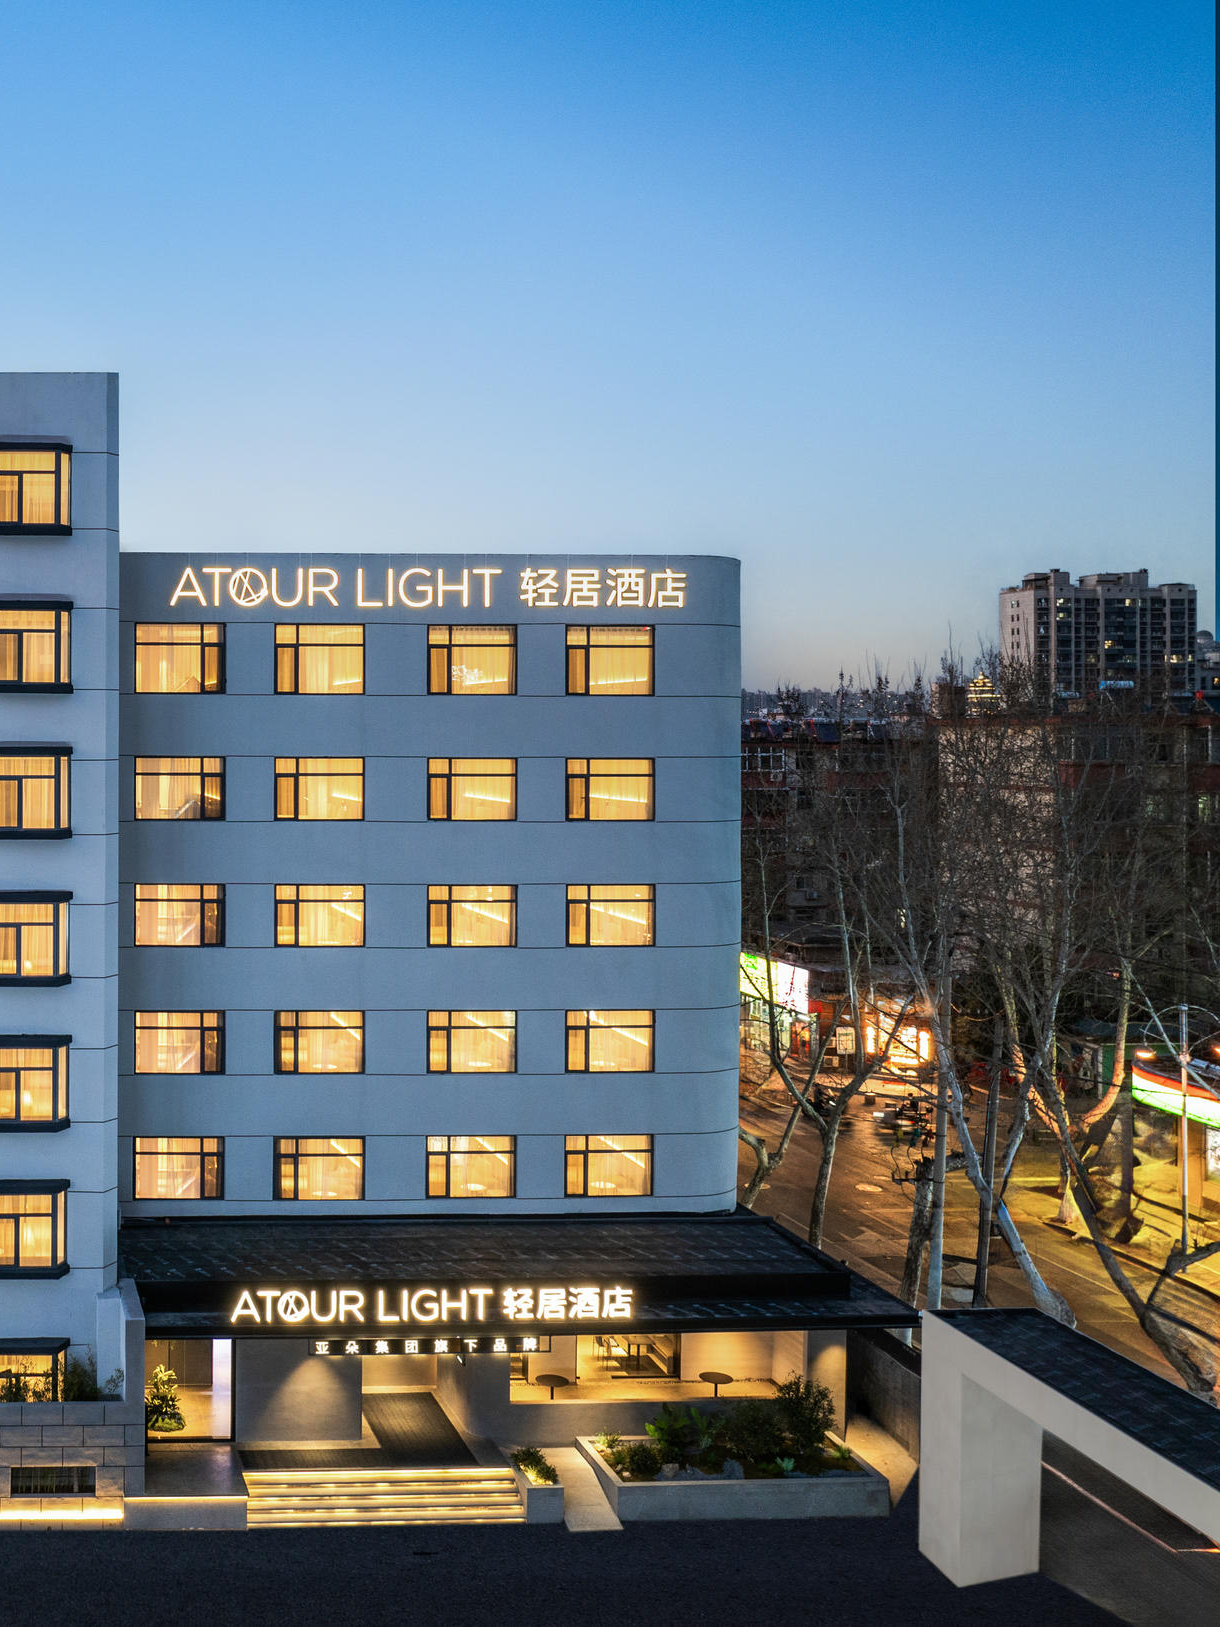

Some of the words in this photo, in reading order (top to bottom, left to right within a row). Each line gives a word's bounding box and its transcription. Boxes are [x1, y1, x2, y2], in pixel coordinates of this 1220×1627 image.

[169, 567, 339, 607] ATOUR
[356, 567, 502, 607] LIGHT
[518, 567, 686, 608] 轻居酒店
[230, 1289, 365, 1323] ATOUR
[377, 1287, 493, 1322] LIGHT
[502, 1286, 633, 1319] 轻居酒店
[314, 1337, 538, 1355] 亚朵集团旗下品牌
